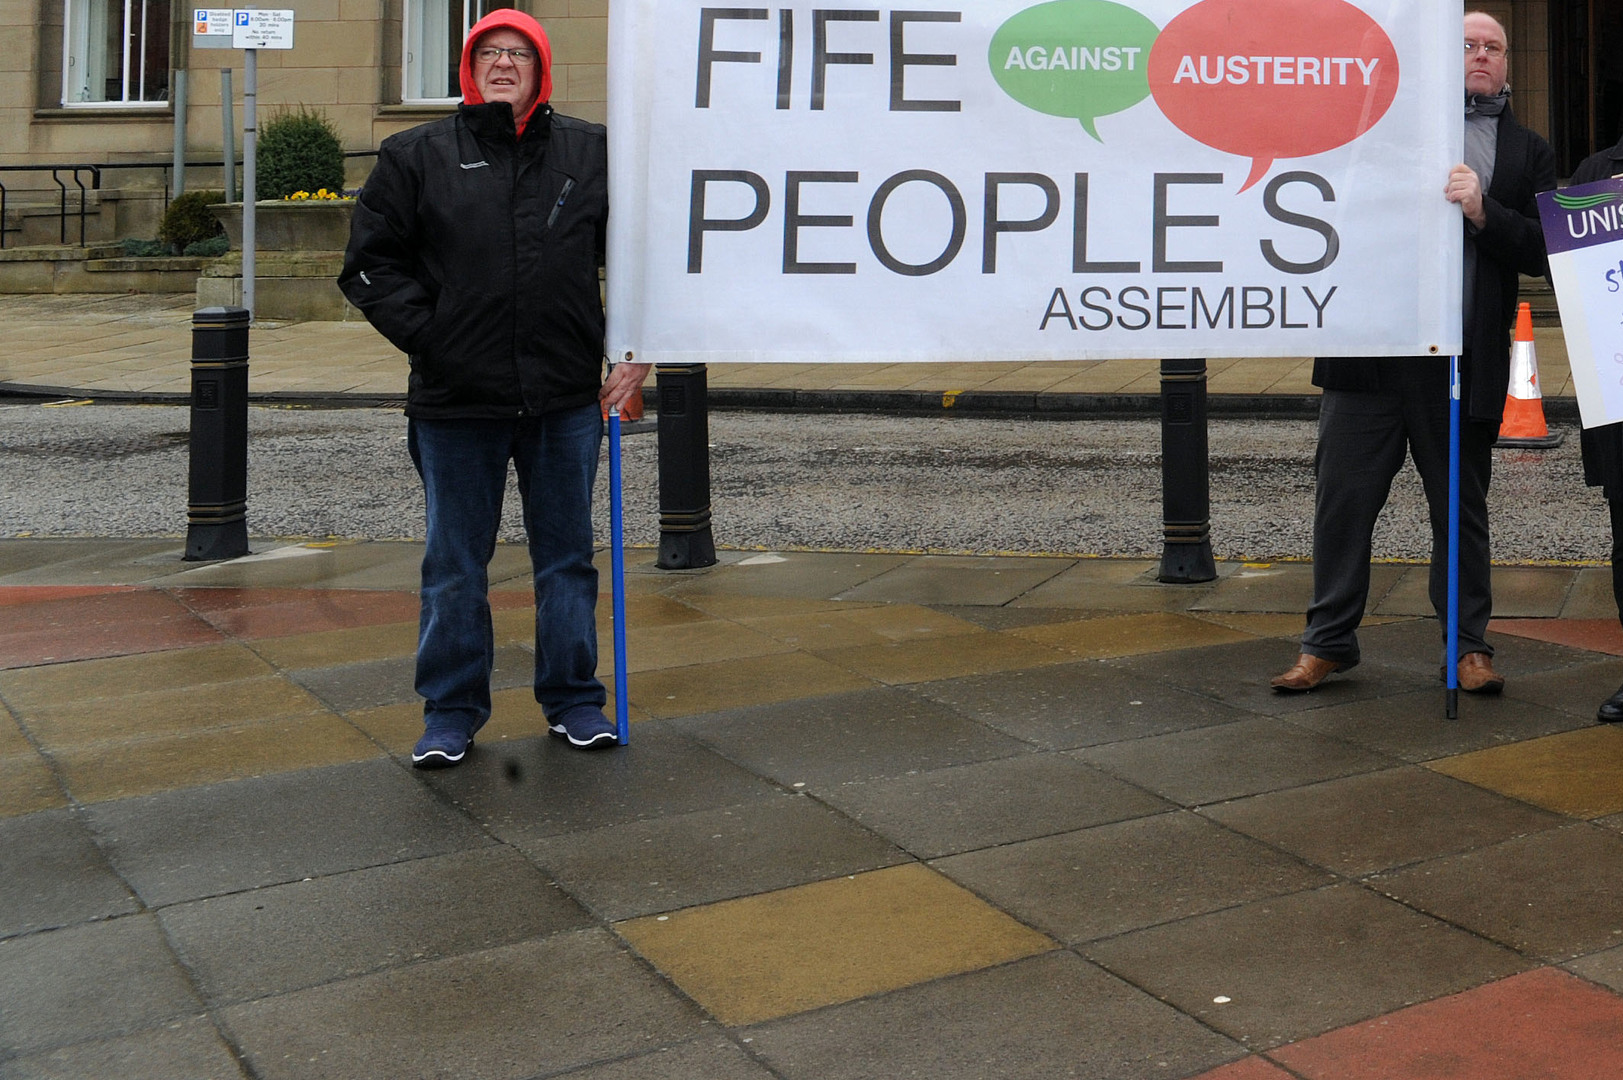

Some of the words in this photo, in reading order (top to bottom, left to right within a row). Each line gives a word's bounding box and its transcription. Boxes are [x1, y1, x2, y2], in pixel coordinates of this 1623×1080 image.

[695, 7, 962, 112] FIFE
[1004, 46, 1141, 71] AGAINST
[1172, 55, 1379, 86] AUSTERITY
[1039, 286, 1338, 331] ASSEMBLY
